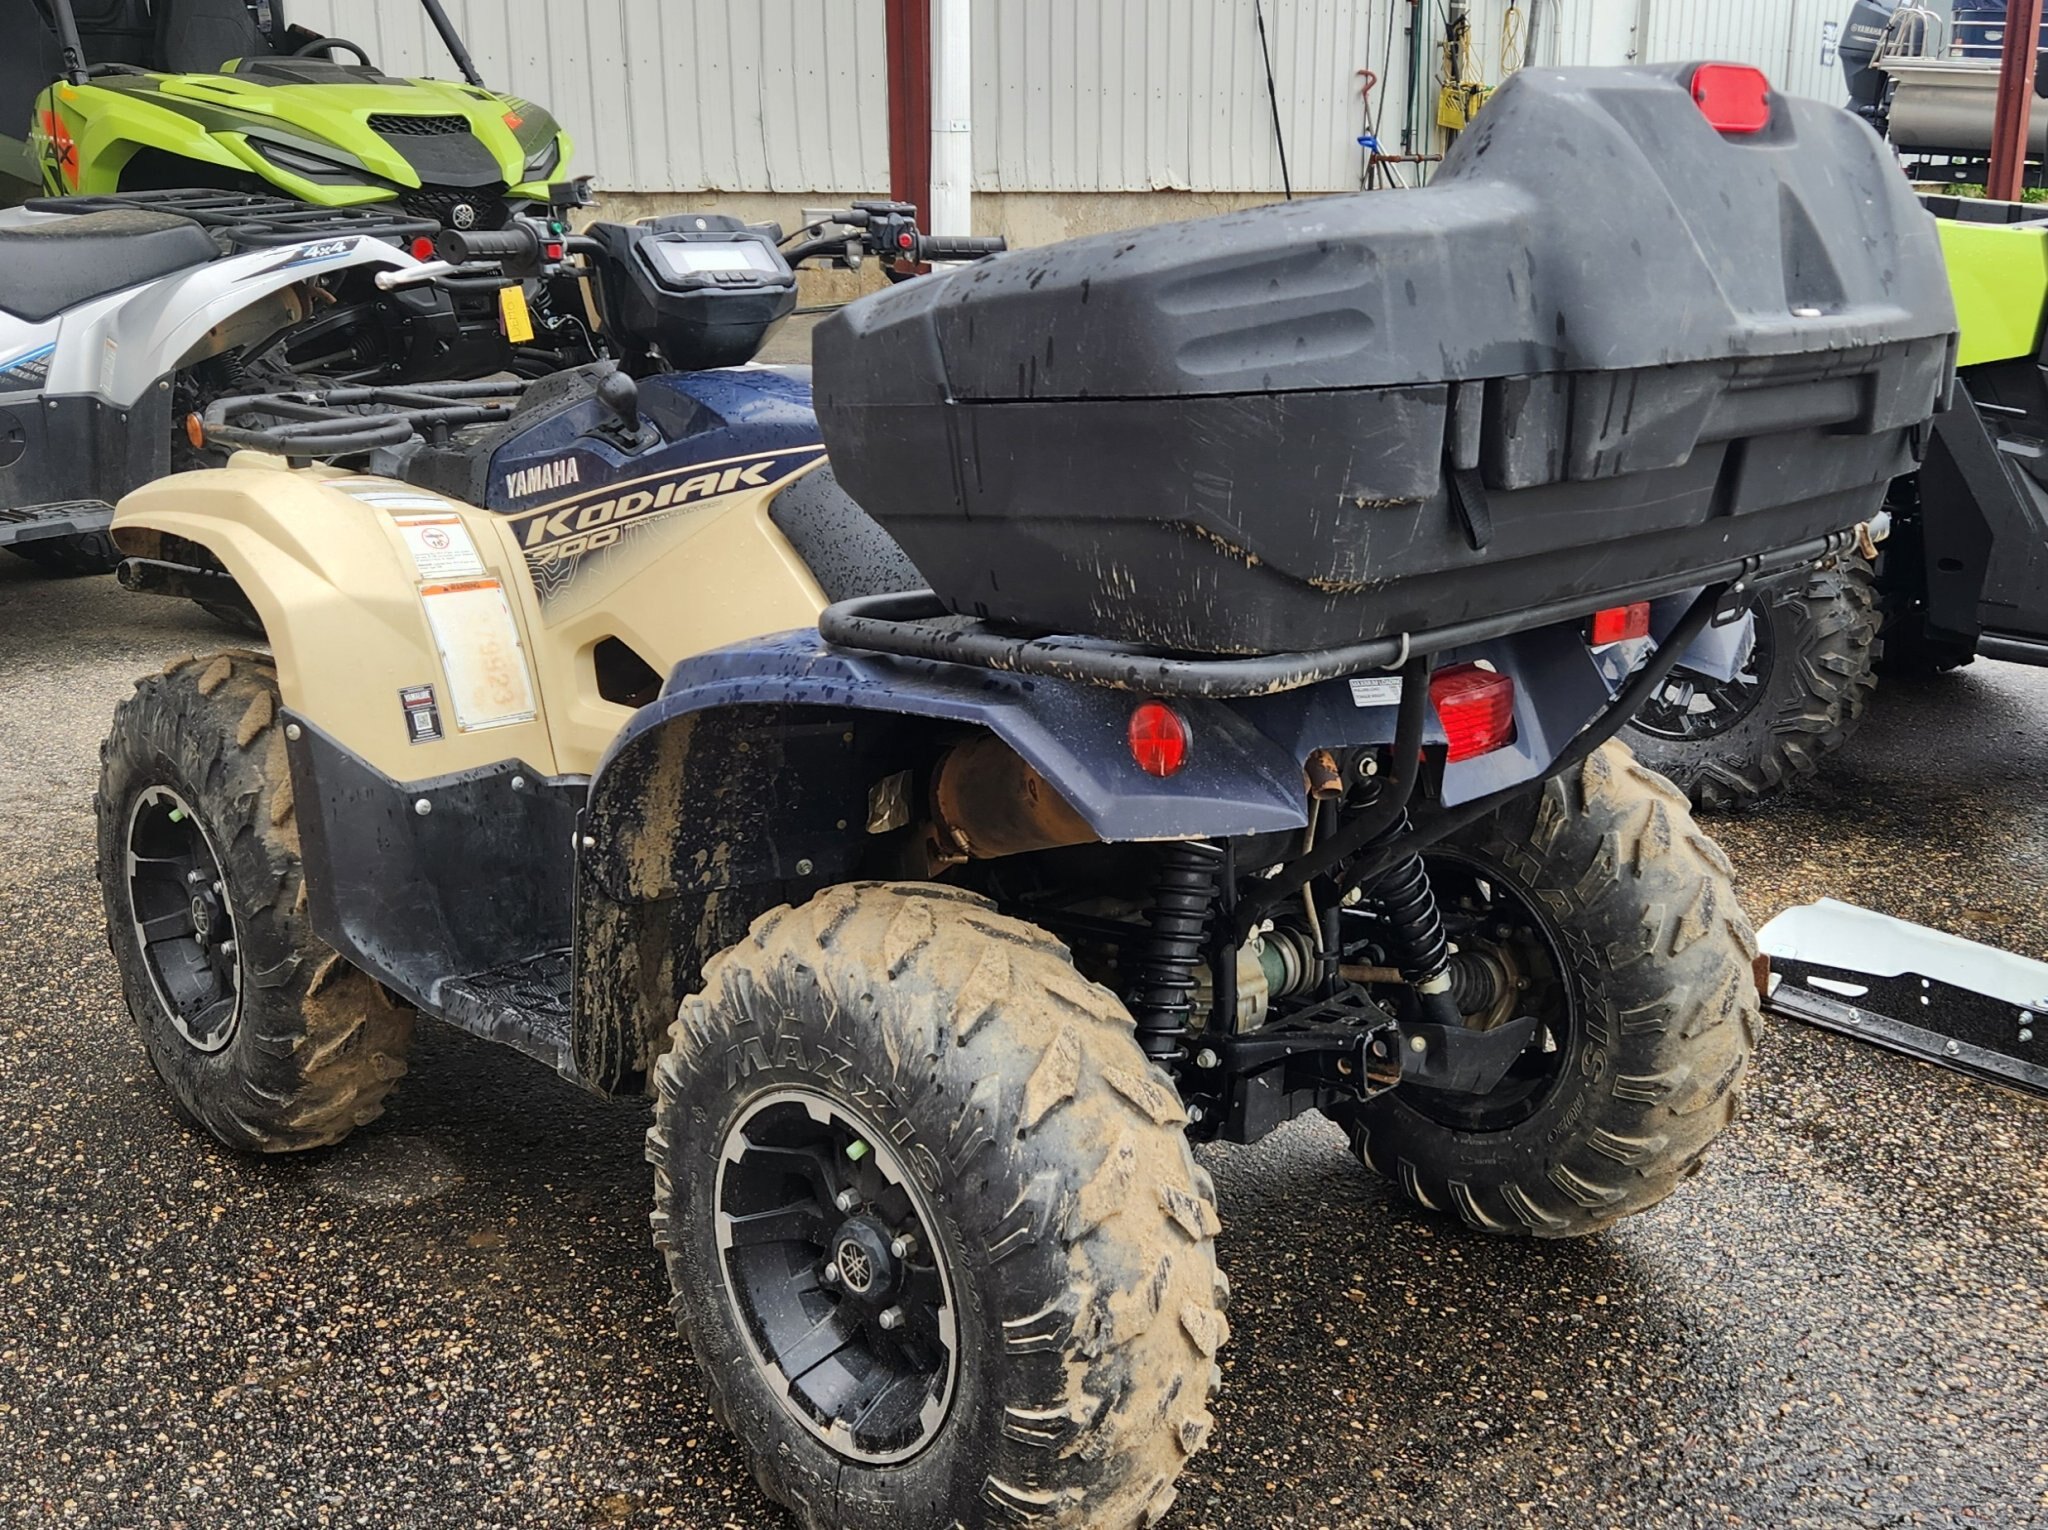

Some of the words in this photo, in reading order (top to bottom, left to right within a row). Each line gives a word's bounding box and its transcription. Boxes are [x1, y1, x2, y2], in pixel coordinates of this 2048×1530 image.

[303, 241, 347, 258] 4x4
[505, 456, 580, 499] YAMAHA
[525, 460, 777, 547] KODIAK
[531, 526, 622, 567] 700
[1484, 838, 1610, 1084] MAXXIS
[726, 1034, 945, 1193] MAXXIS
